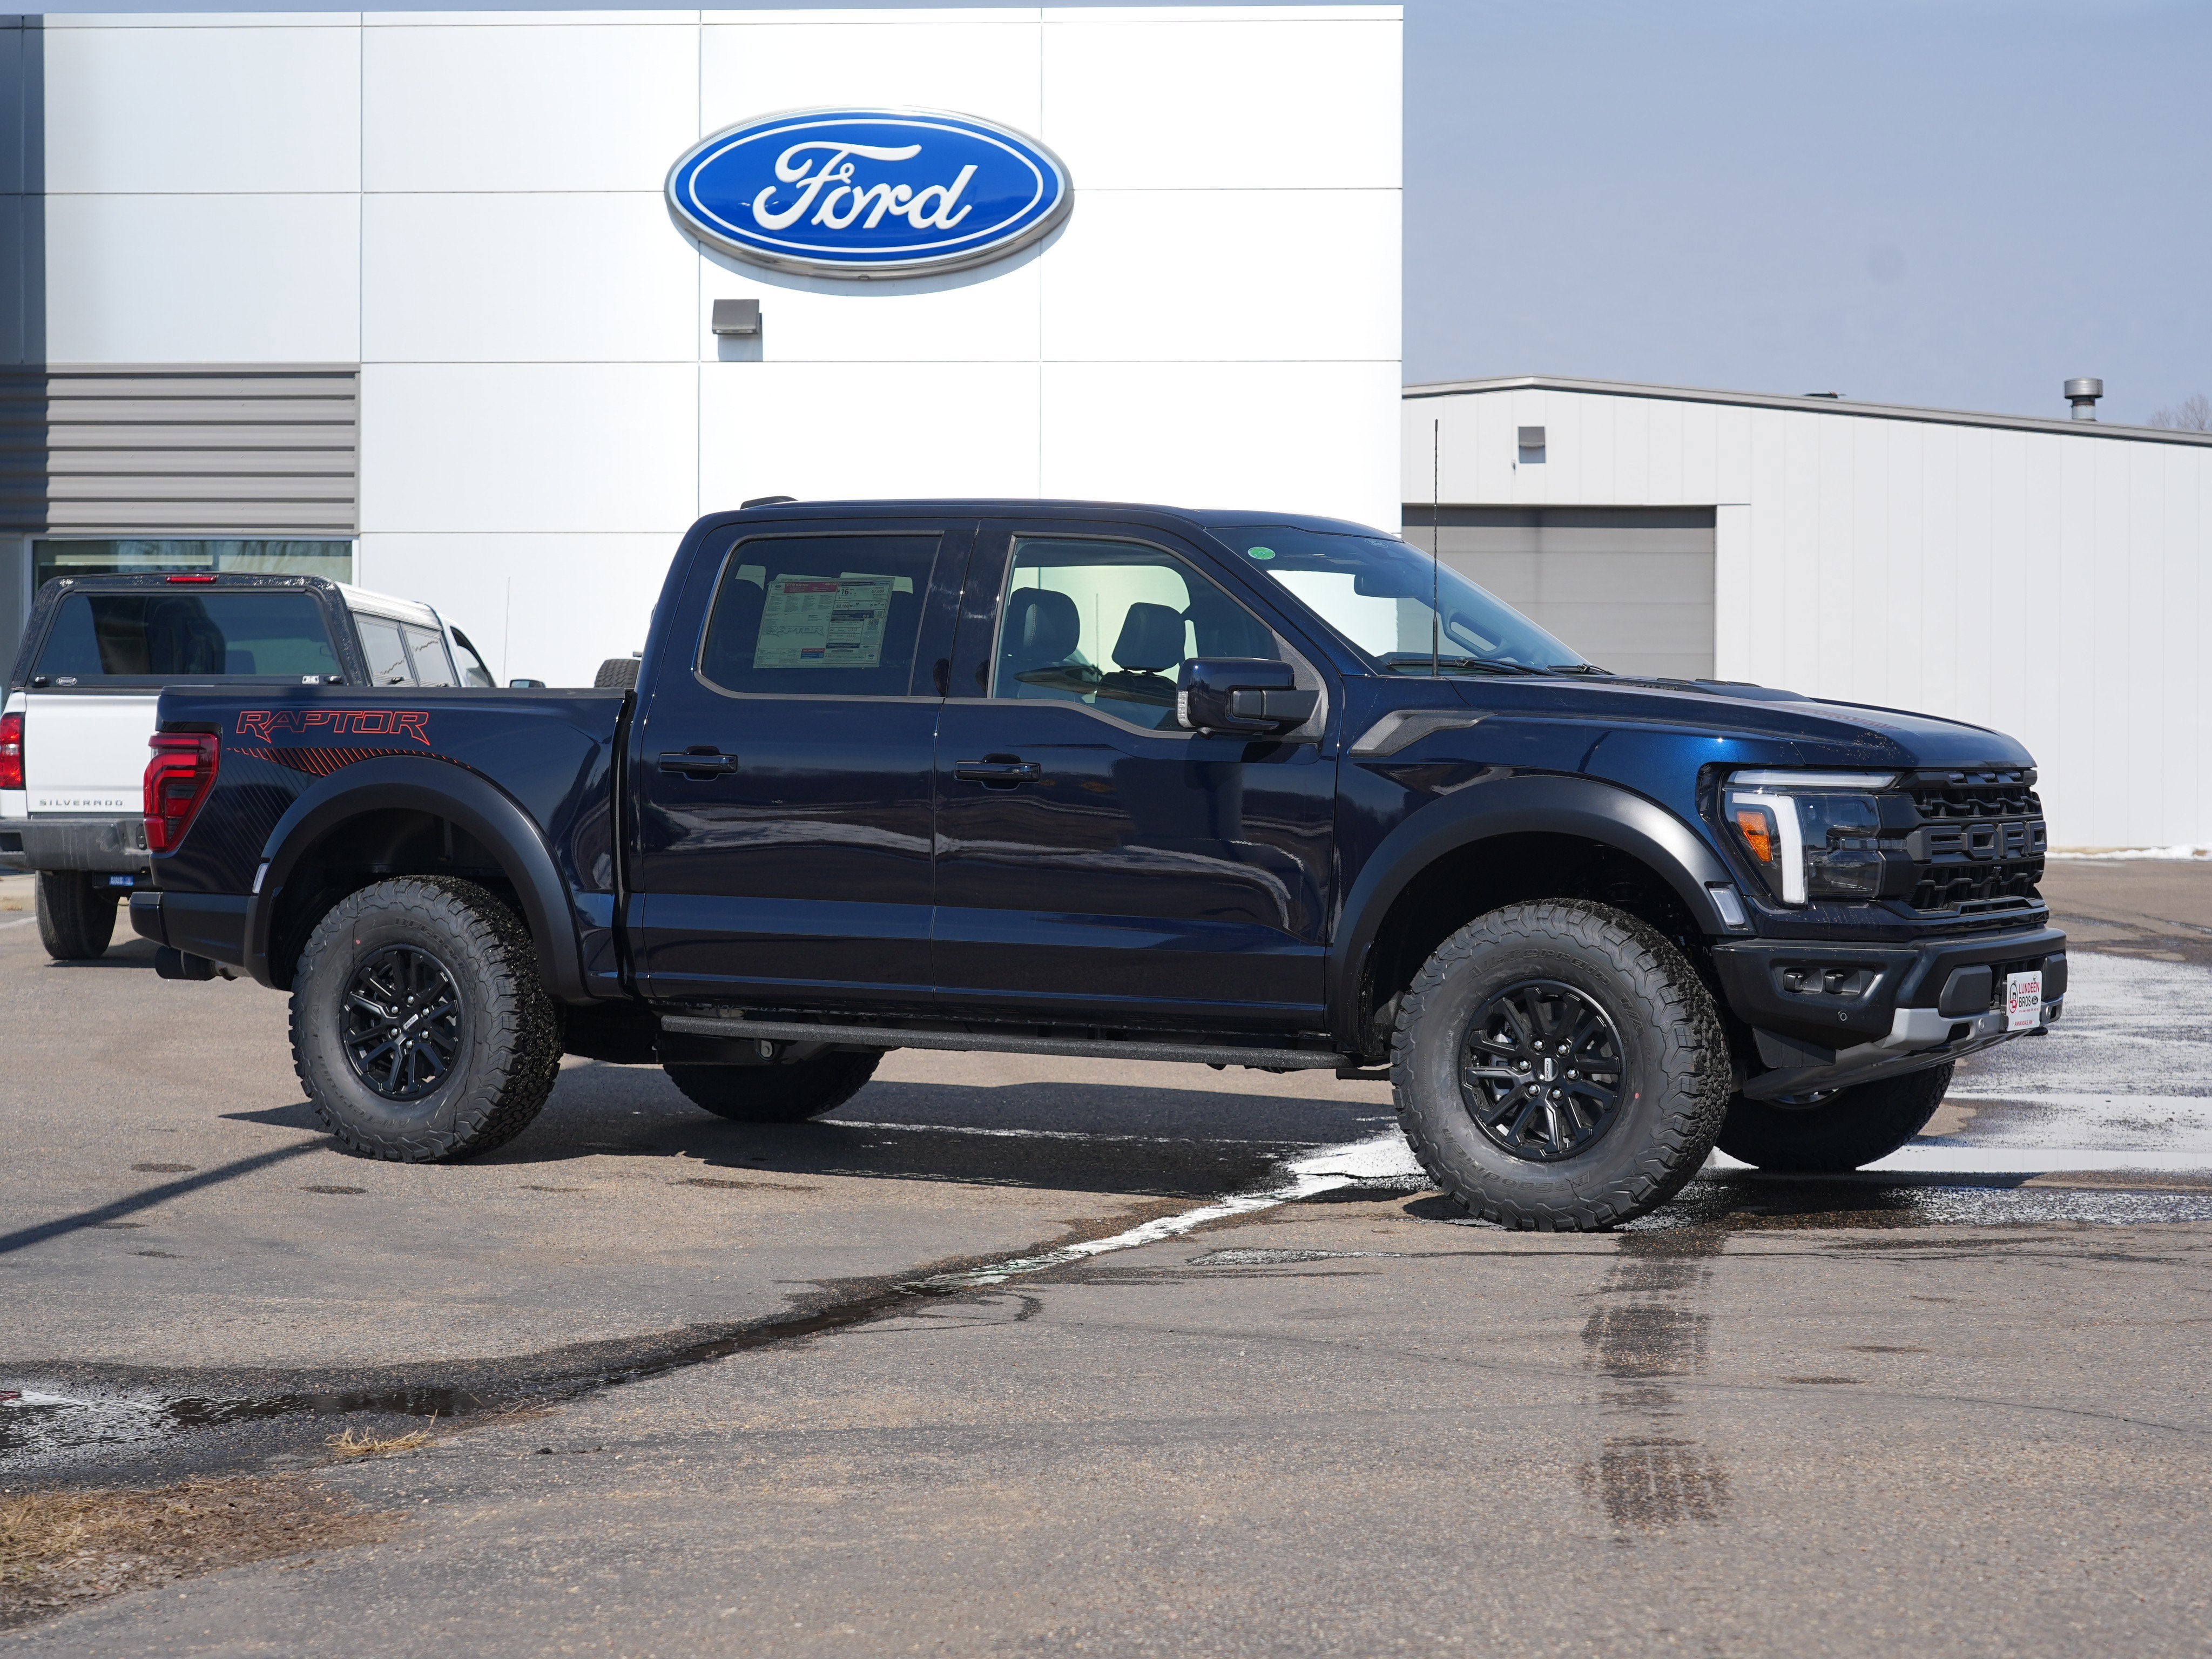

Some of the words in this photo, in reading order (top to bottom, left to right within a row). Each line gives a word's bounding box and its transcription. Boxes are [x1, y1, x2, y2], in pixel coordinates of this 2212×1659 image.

[752, 141, 978, 230] Ford
[766, 625, 825, 637] RAPTOR
[235, 710, 430, 745] RAPTOR
[39, 799, 124, 807] SILVERADO
[1905, 820, 2047, 864] FORD
[1467, 948, 1612, 986] All-Terrain
[2019, 982, 2040, 994] LUNDEEN
[2019, 995, 2031, 1007] BROS
[1618, 997, 1645, 1039] T/A
